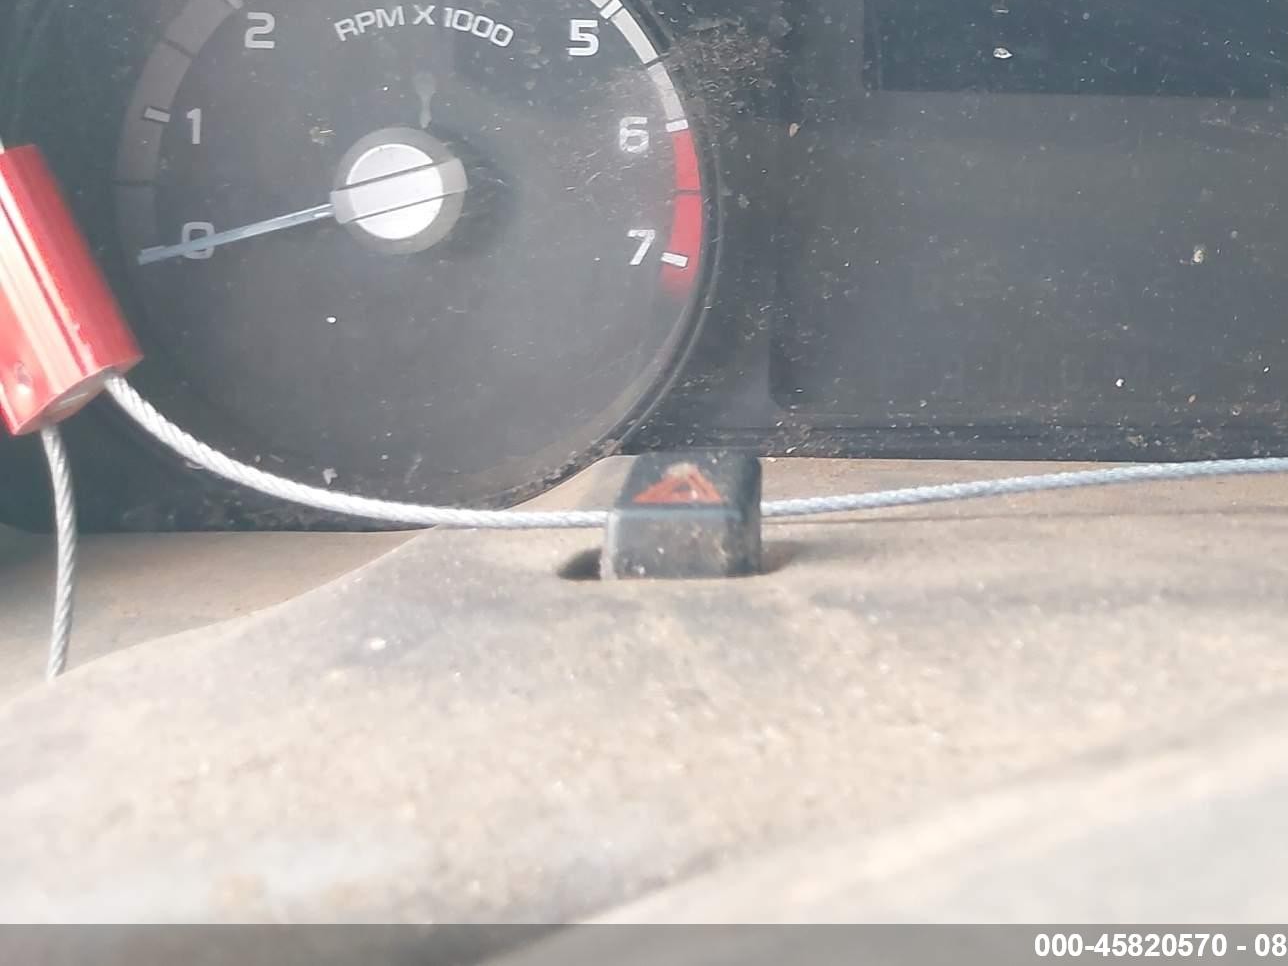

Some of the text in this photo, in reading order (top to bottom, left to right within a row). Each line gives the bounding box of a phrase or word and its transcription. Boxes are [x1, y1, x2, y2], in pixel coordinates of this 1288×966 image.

[245, 12, 275, 49] 2
[335, 5, 513, 47] RPM X 1000
[568, 19, 599, 56] 5
[186, 108, 201, 144] 1
[619, 117, 649, 152] 6
[181, 222, 215, 259] 0
[628, 229, 656, 265] 7
